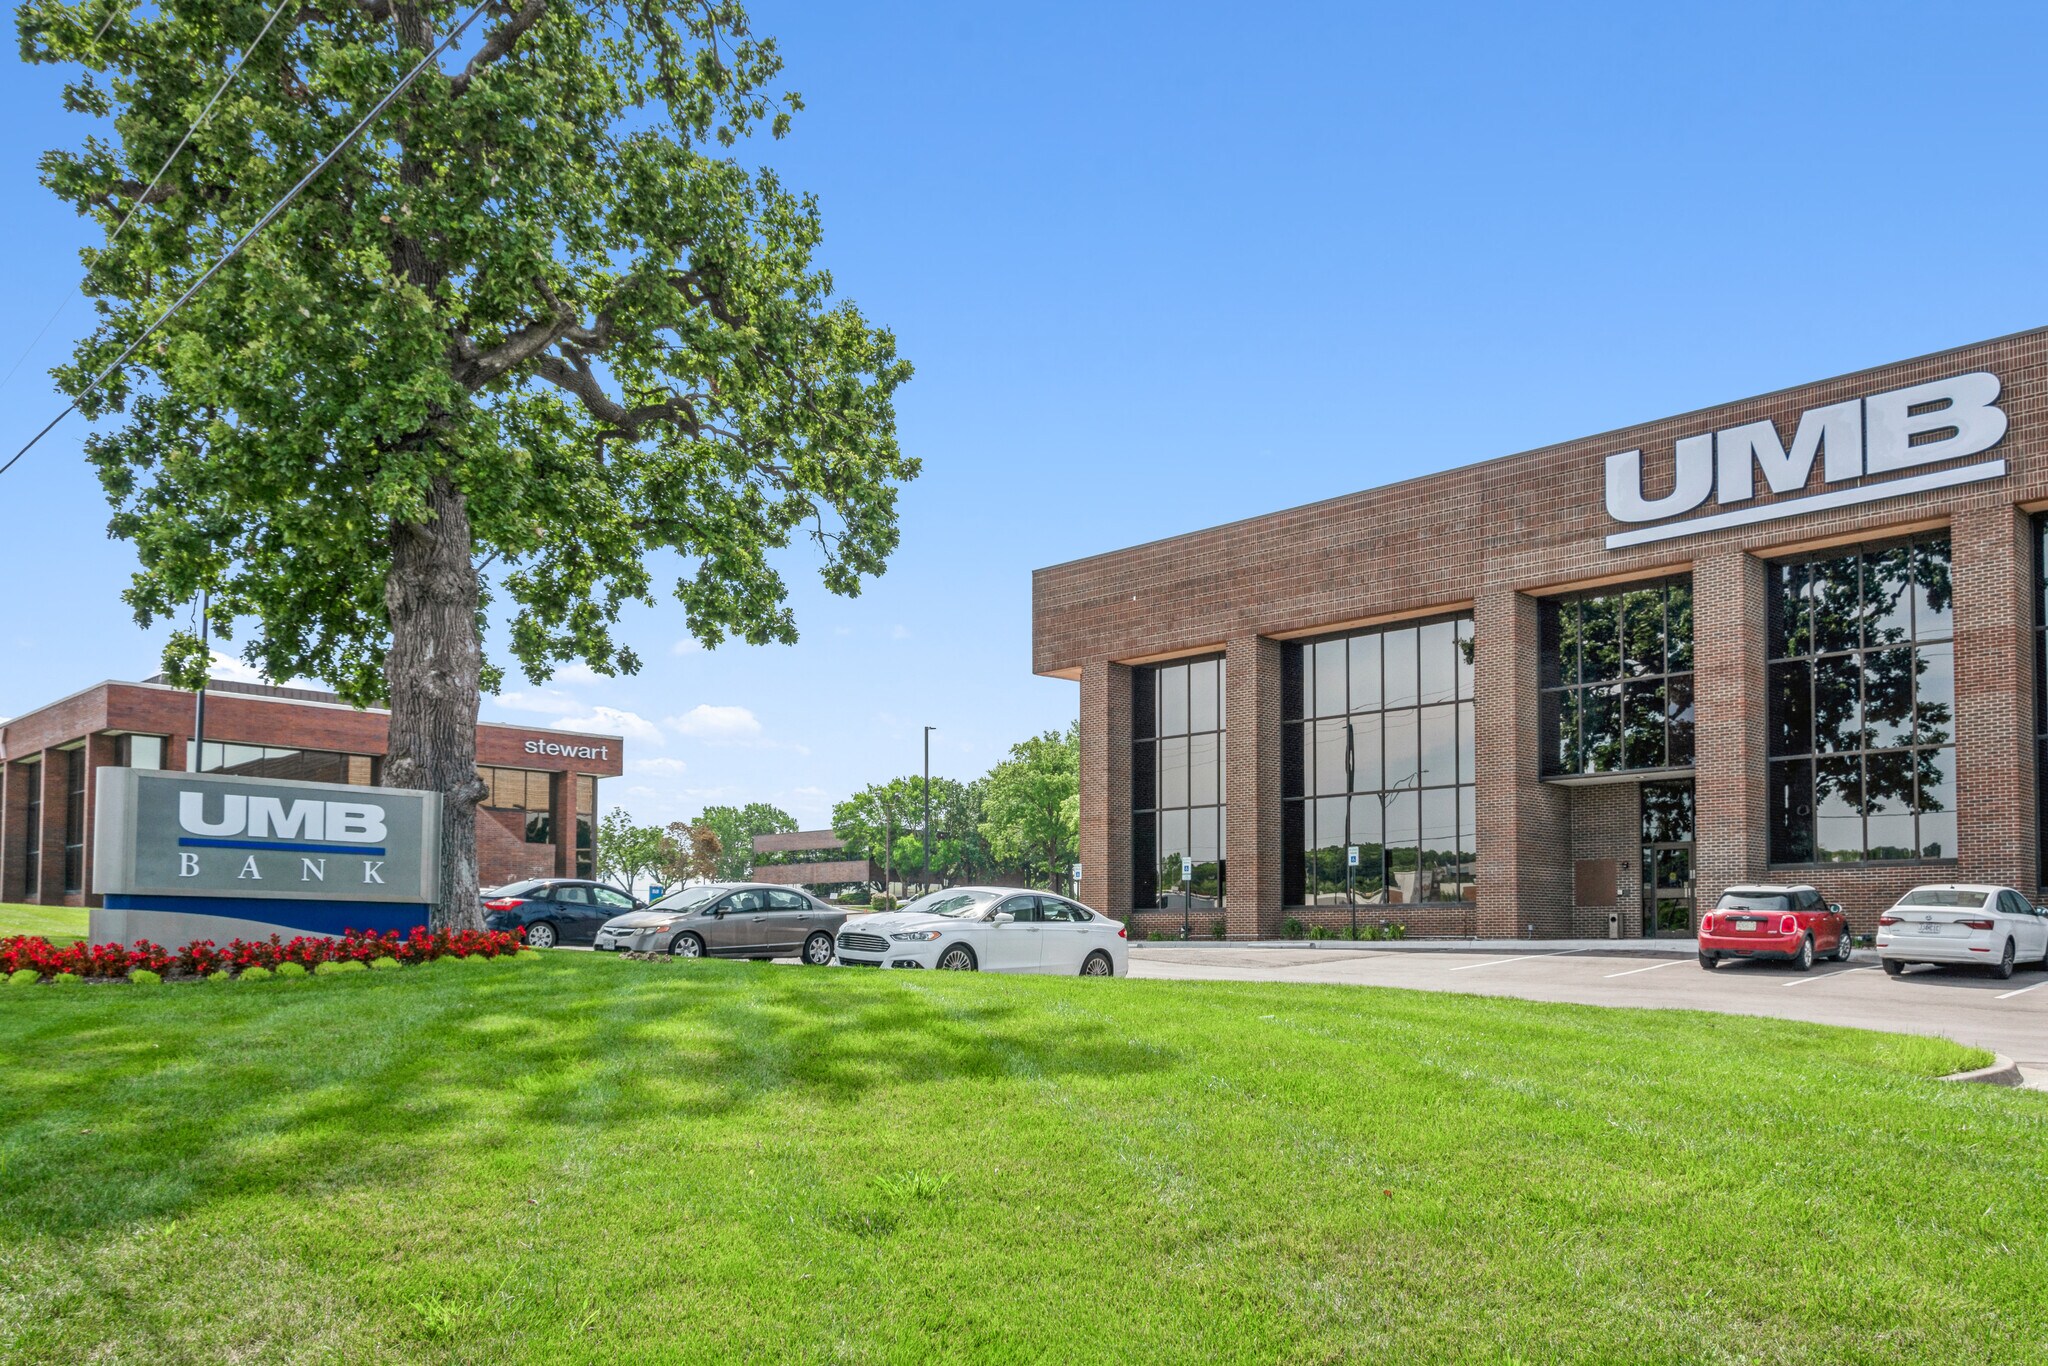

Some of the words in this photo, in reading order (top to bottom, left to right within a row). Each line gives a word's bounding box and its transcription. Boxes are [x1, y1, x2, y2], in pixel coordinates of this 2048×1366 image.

[1605, 372, 2008, 523] UMB
[524, 739, 608, 761] stewart
[179, 791, 388, 843] UMB
[178, 852, 386, 884] BANK
